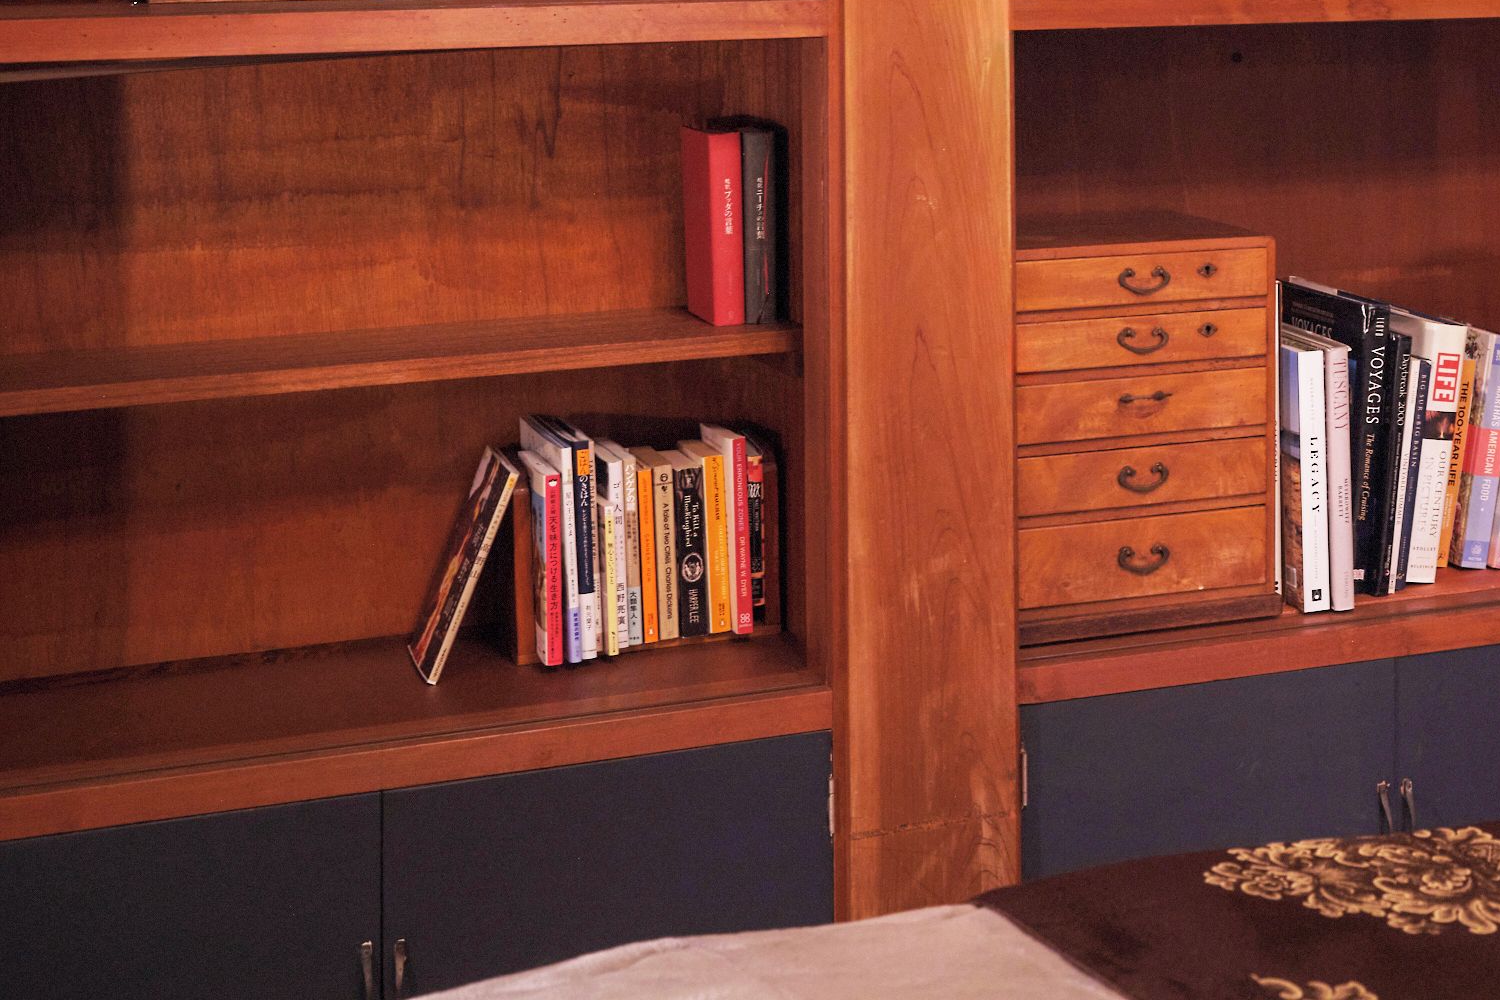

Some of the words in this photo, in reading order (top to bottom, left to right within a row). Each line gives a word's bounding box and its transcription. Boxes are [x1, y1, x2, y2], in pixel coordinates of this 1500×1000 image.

[1365, 346, 1386, 425] VOYAGES
[1398, 353, 1410, 398] Daybreak
[1434, 355, 1458, 402] LIFE
[1332, 358, 1349, 430] TUSCANY
[1460, 382, 1470, 403] THE
[1396, 401, 1406, 426] 2000
[1365, 433, 1375, 446] The
[1451, 405, 1466, 460] 100-YEAR
[1361, 446, 1374, 480] Romance
[1410, 440, 1418, 468] BASIN
[1437, 450, 1446, 476] OUR
[1484, 430, 1499, 474] AMERICAN
[1310, 436, 1321, 512] LEGACY
[1447, 463, 1457, 487] LIFE
[1358, 490, 1370, 522] Cruising
[1480, 479, 1492, 502] FOOD
[682, 495, 692, 548] Mockingbird
[692, 502, 699, 512] To
[1429, 481, 1443, 537] CENTURY
[689, 588, 699, 610] HARPER
[690, 611, 700, 624] LEE
